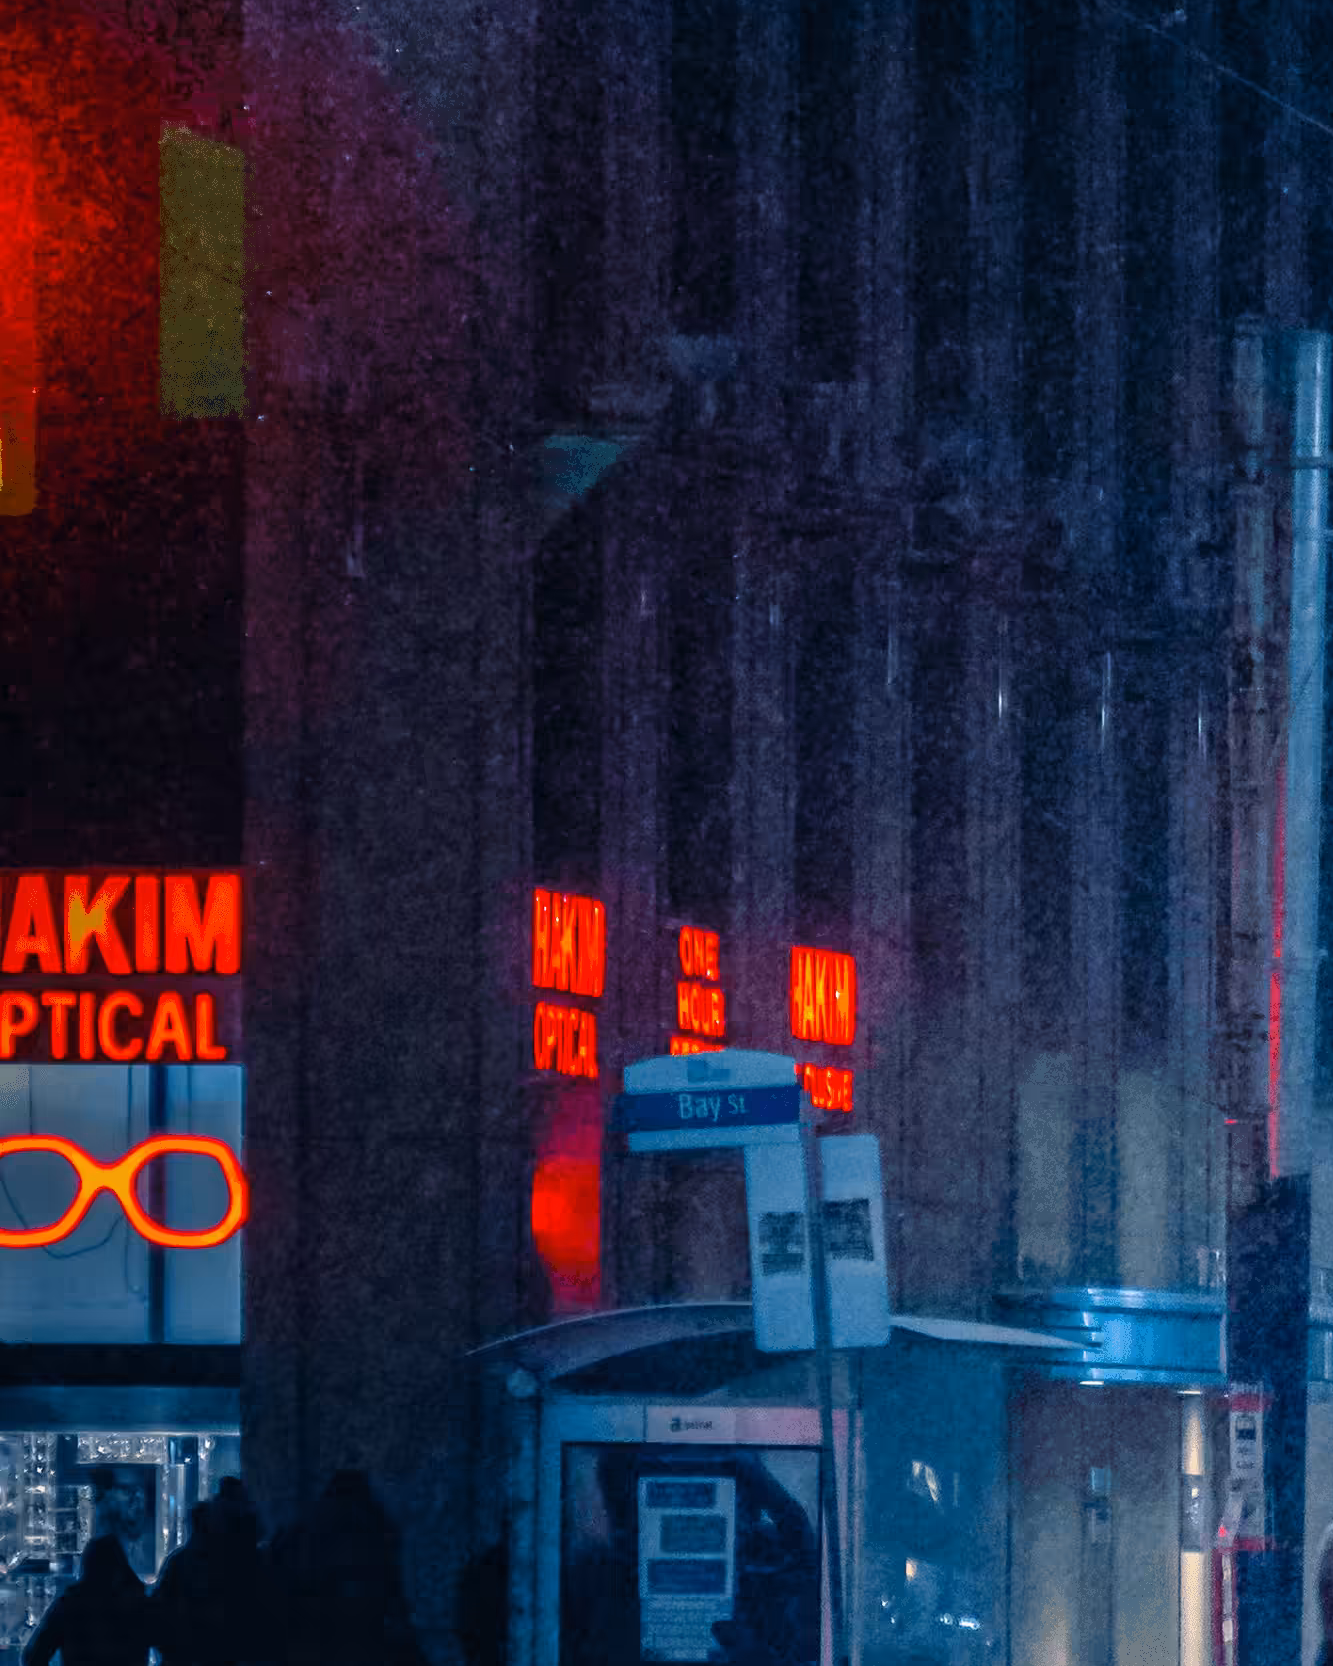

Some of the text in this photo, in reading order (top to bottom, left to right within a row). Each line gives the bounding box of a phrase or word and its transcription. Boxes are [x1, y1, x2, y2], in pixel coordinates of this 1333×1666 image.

[1, 874, 240, 973] AKIM
[533, 888, 606, 997] HAKIM
[679, 925, 720, 981] ONE
[0, 990, 227, 1060] PTICAL
[677, 981, 725, 1037] HOUR
[790, 945, 857, 1046] HAKIM
[679, 1093, 748, 1122] Bay St
